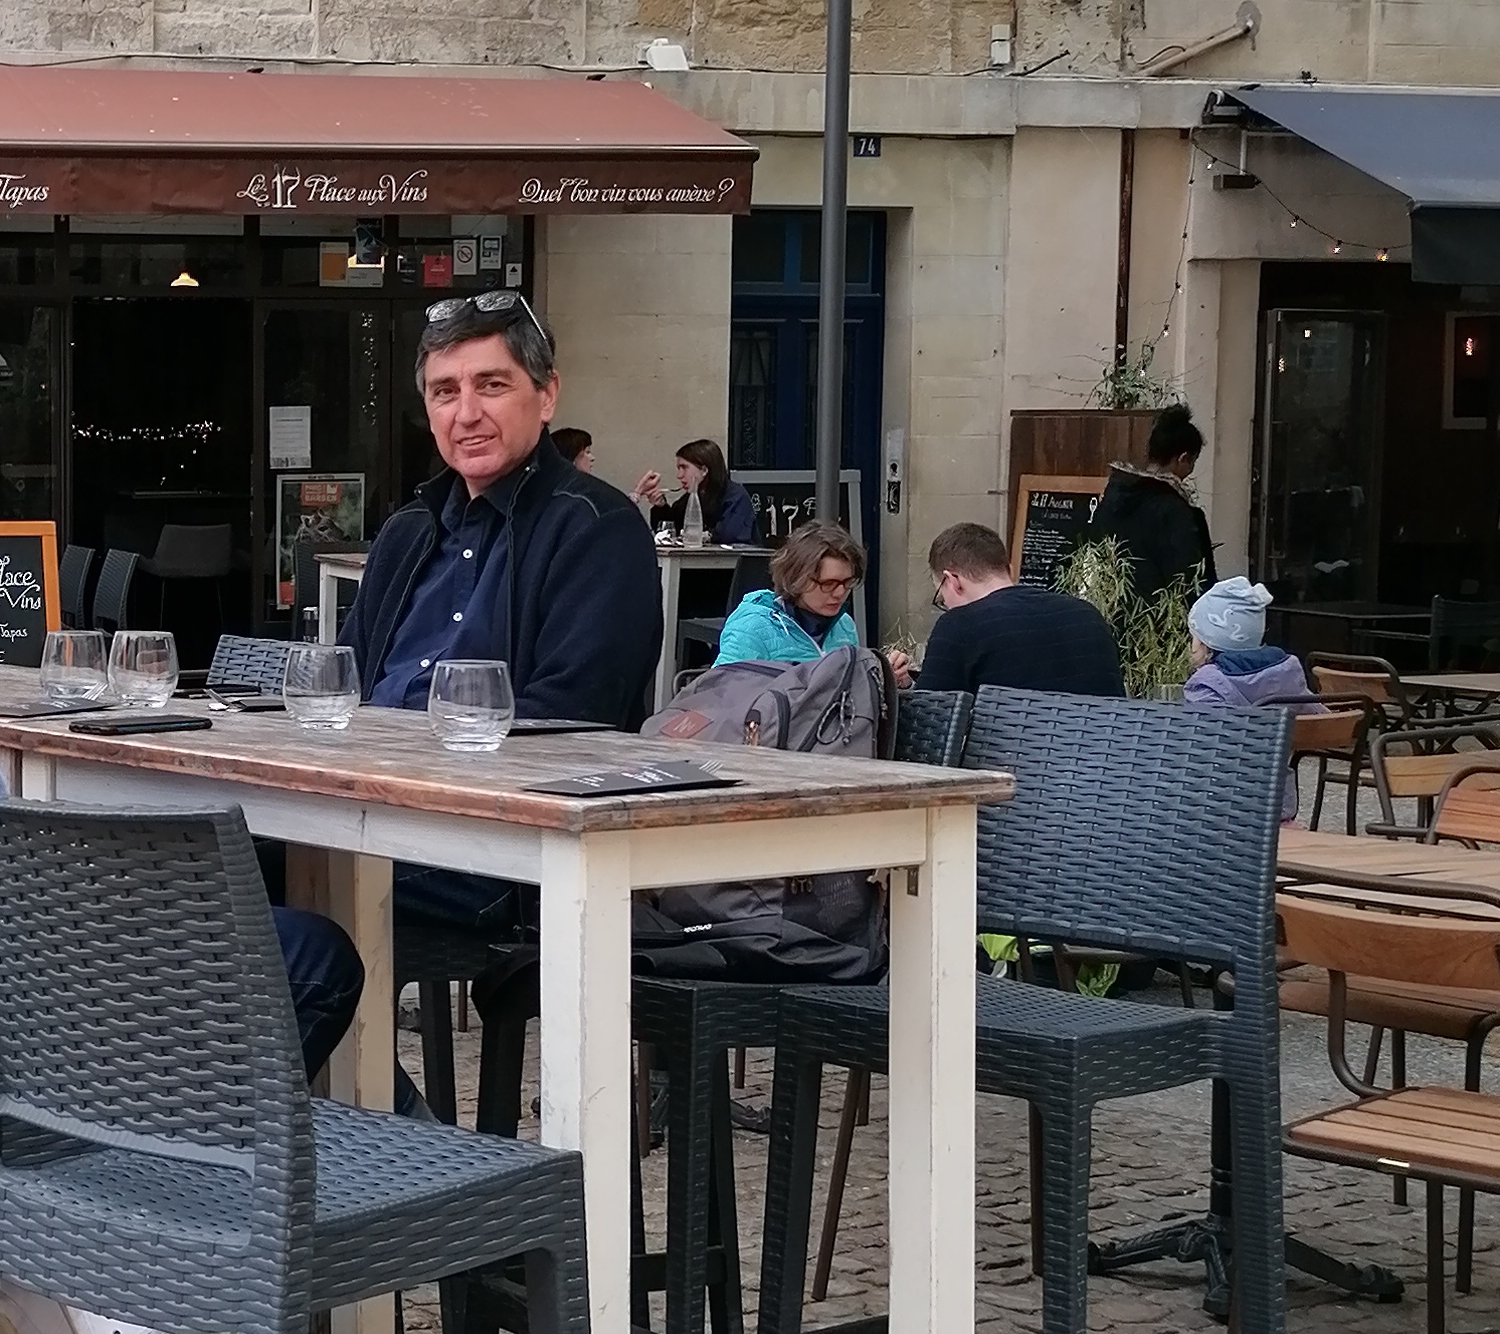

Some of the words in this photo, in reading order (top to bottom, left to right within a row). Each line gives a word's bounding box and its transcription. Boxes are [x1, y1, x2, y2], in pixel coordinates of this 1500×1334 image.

[859, 138, 876, 155] 74
[271, 167, 301, 208] 17
[304, 174, 356, 201] Place
[357, 187, 387, 206] aux
[379, 169, 428, 203] Vins
[518, 177, 573, 204] Quel
[570, 178, 599, 203] bon
[601, 183, 625, 202] vin
[627, 186, 662, 203] vous
